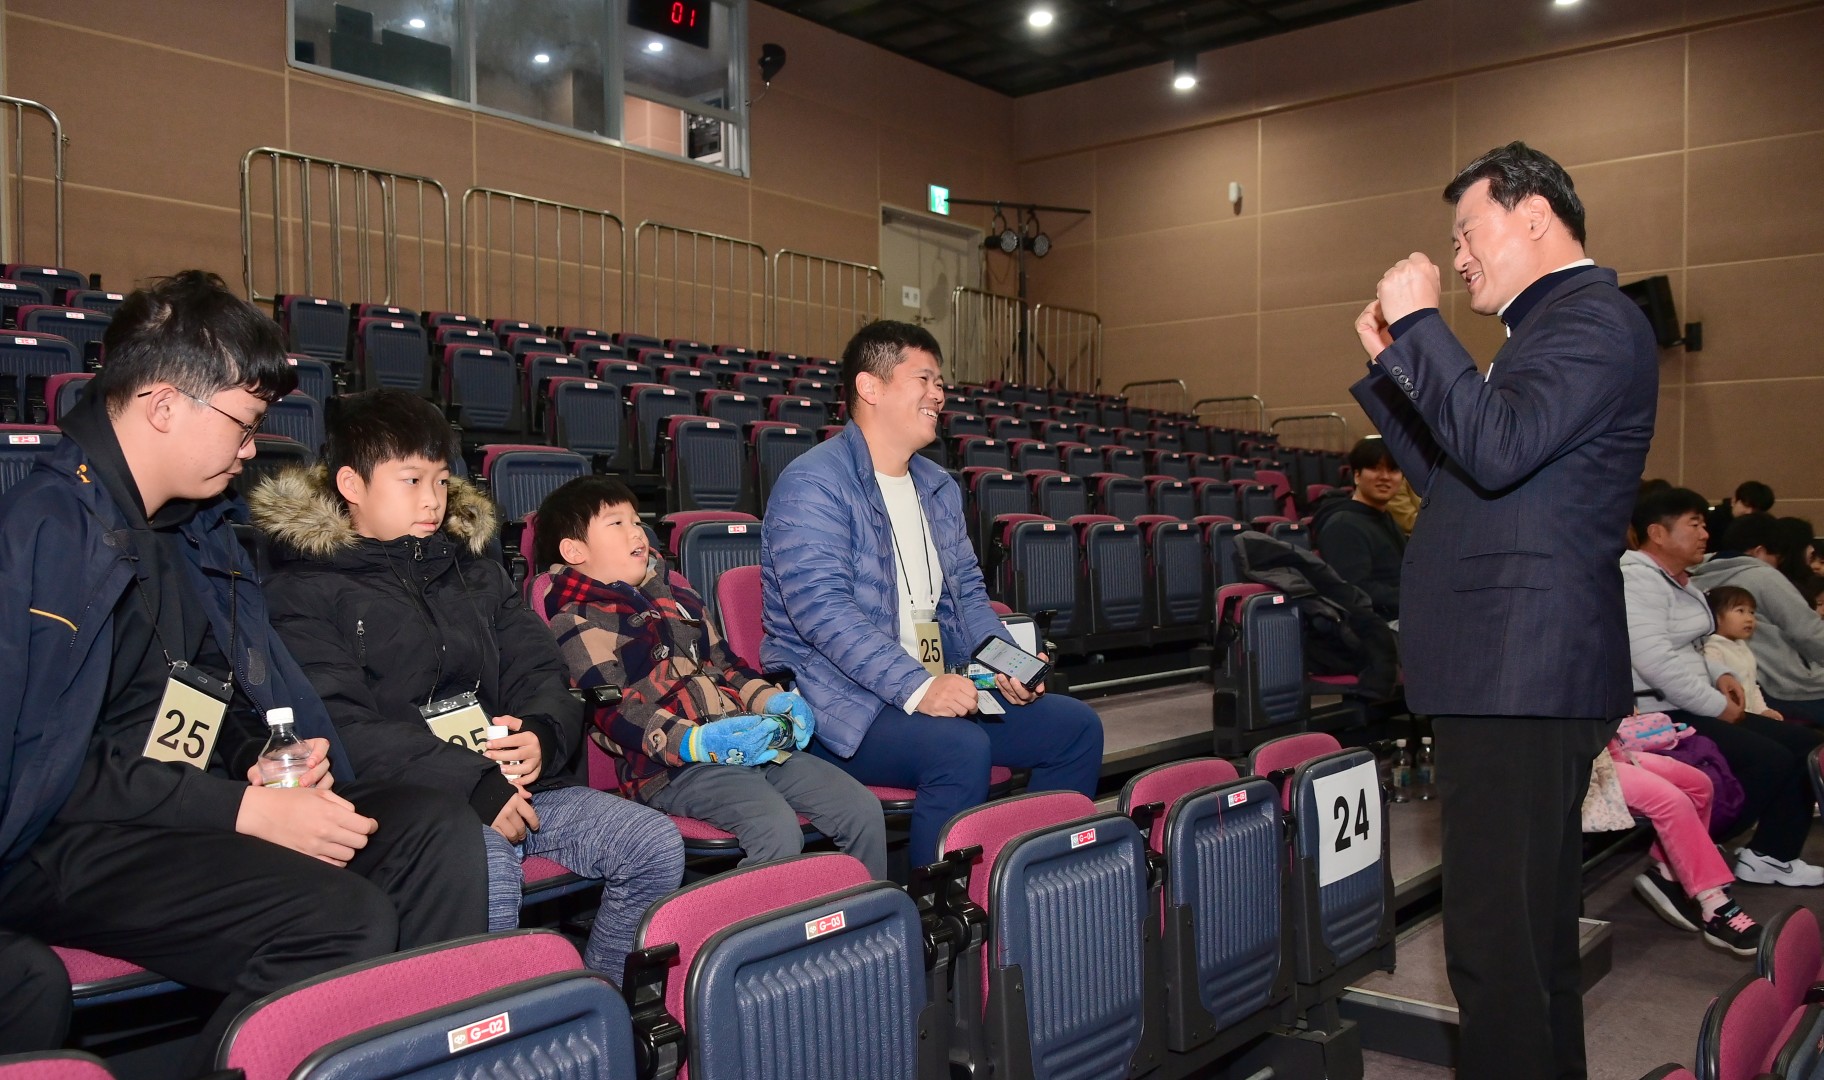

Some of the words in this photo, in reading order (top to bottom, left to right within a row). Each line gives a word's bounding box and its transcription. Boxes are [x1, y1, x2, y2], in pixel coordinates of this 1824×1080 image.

[671, 2, 695, 27] 01
[920, 638, 941, 663] 25
[156, 709, 210, 759] 25
[1333, 788, 1370, 853] 24
[819, 915, 841, 931] G-03
[470, 1019, 504, 1041] G-02
